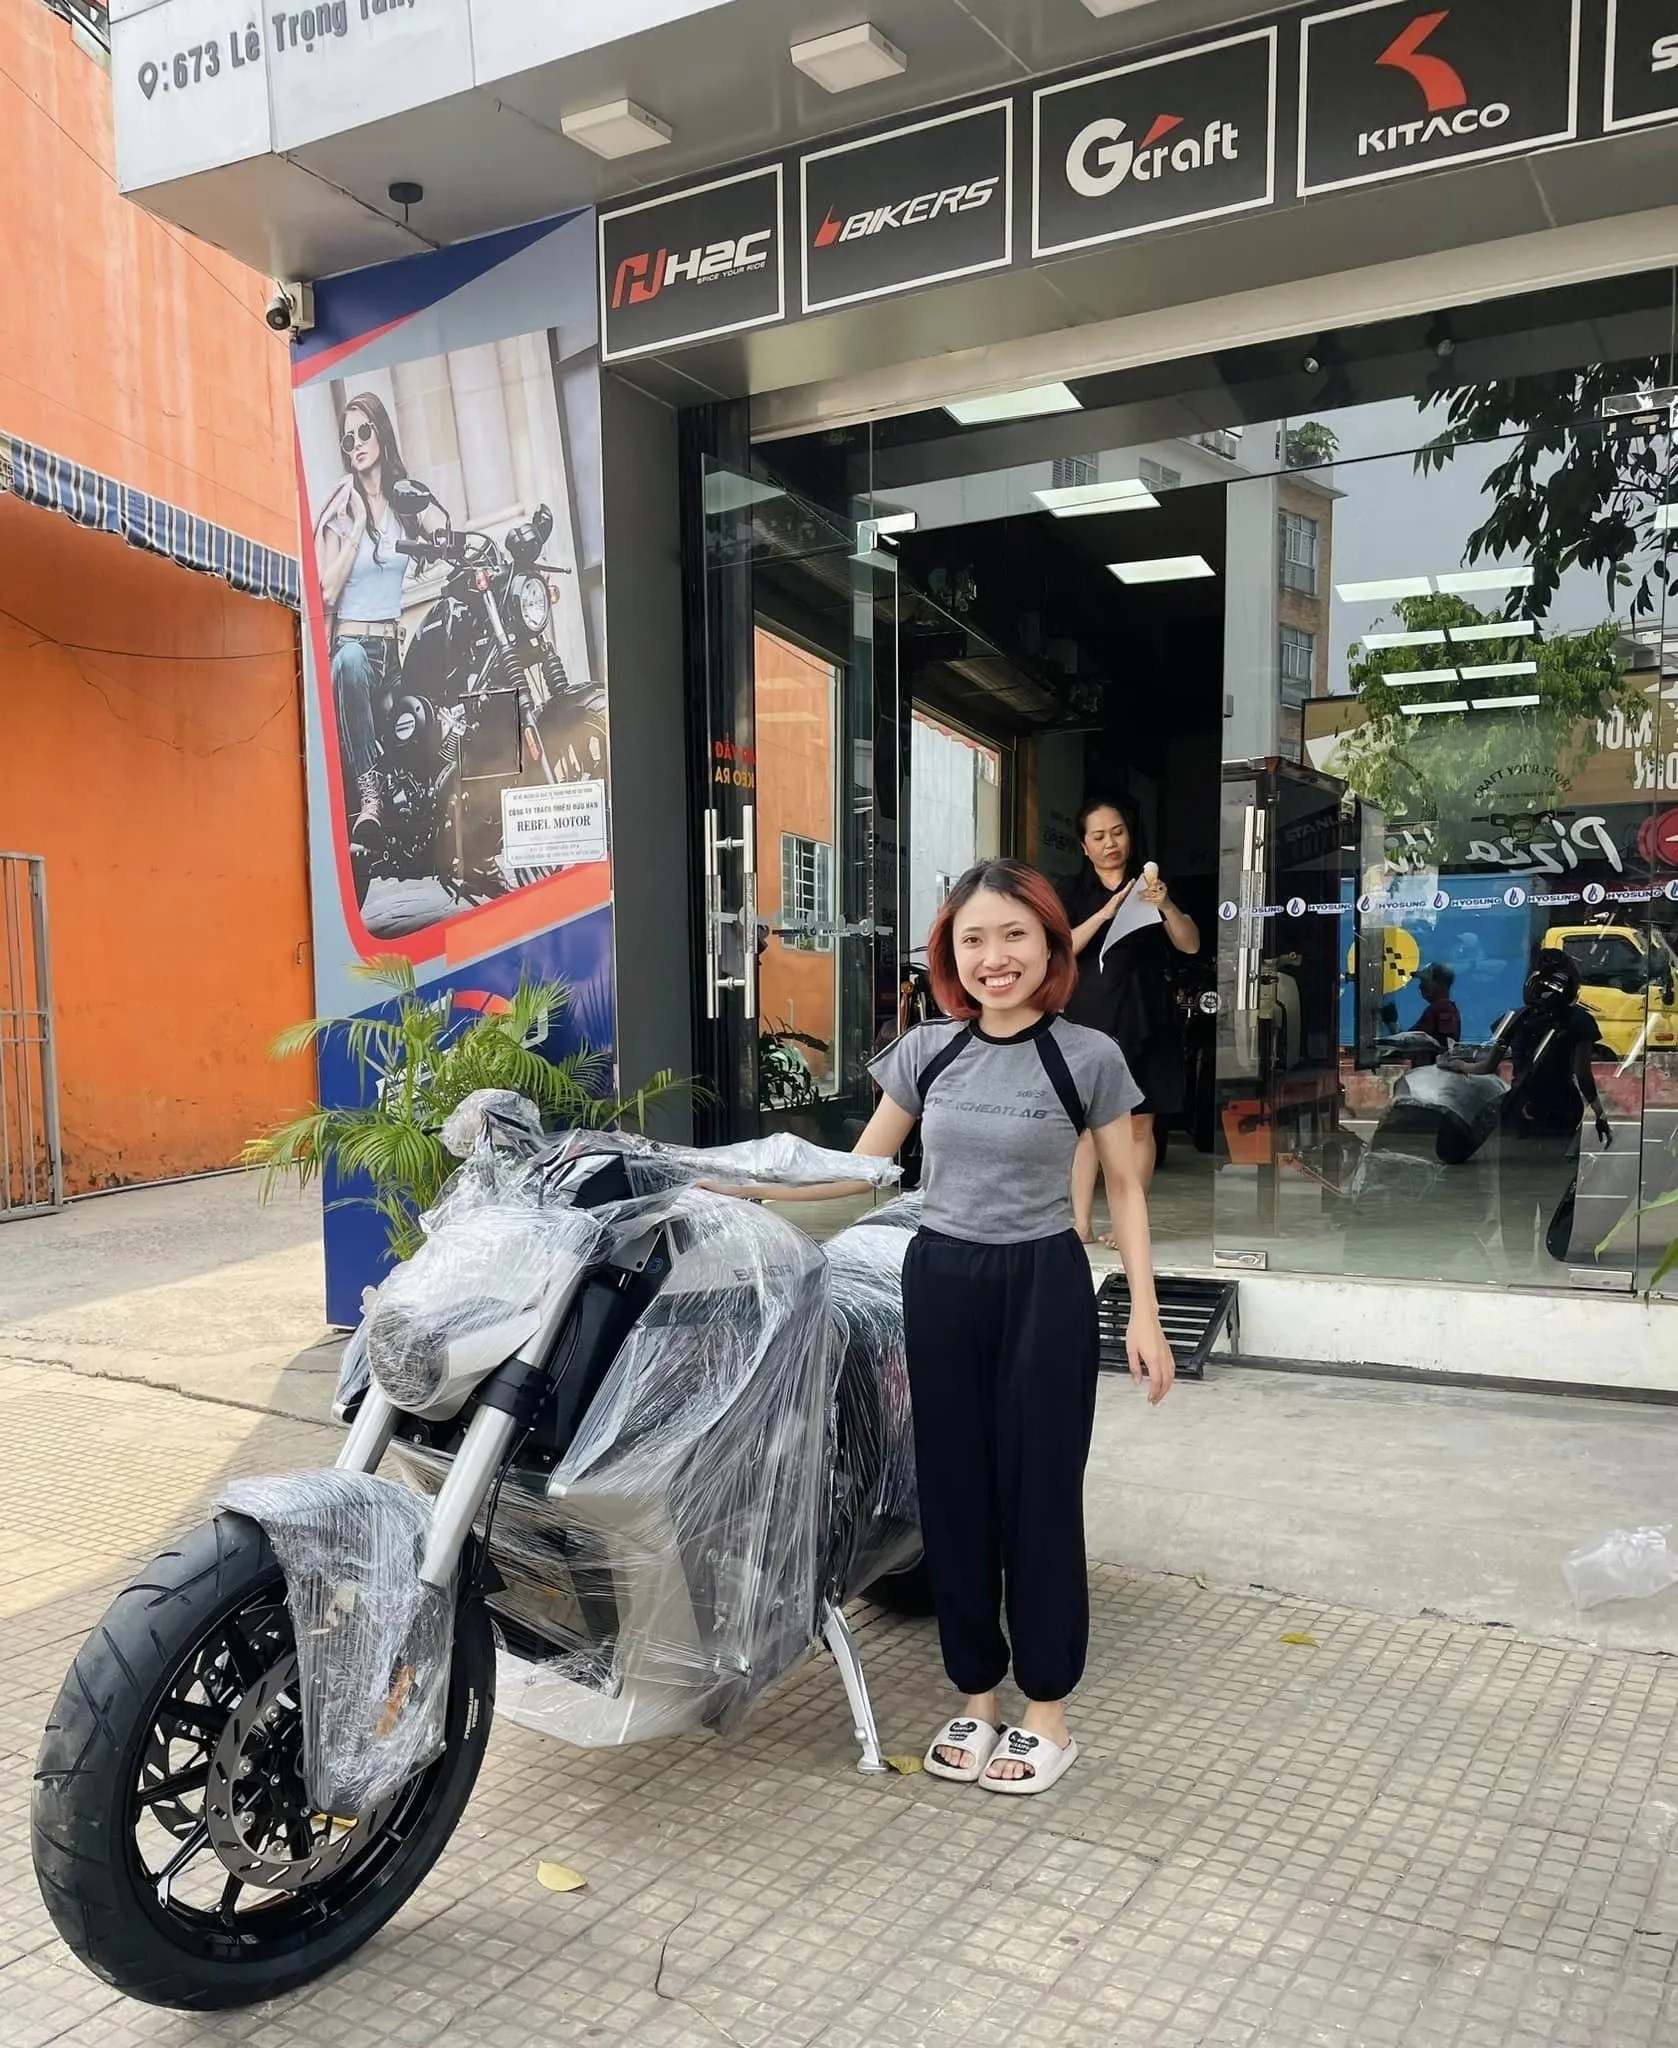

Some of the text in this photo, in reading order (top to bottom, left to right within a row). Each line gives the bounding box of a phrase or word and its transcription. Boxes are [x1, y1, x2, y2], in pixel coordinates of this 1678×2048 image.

[230, 22, 260, 68] Lê
[272, 0, 348, 52] Trọng
[1357, 101, 1511, 156] KITACO
[1065, 117, 1239, 197] Gcraft
[838, 176, 1000, 243] BIKERS
[663, 229, 772, 287] H2C
[697, 261, 766, 285] SPICE YOUR RIDE
[1474, 768, 1504, 798] CRAFT
[1507, 764, 1539, 776] YOUR
[517, 815, 591, 832] REBEL MOTOR
[1308, 903, 1354, 911] HYOSUNG
[1379, 901, 1426, 909] HYOSUNG
[1452, 898, 1500, 906] HYOSUNG
[1528, 894, 1580, 902] HYOSUNG
[1607, 891, 1662, 899] HYOSUNG
